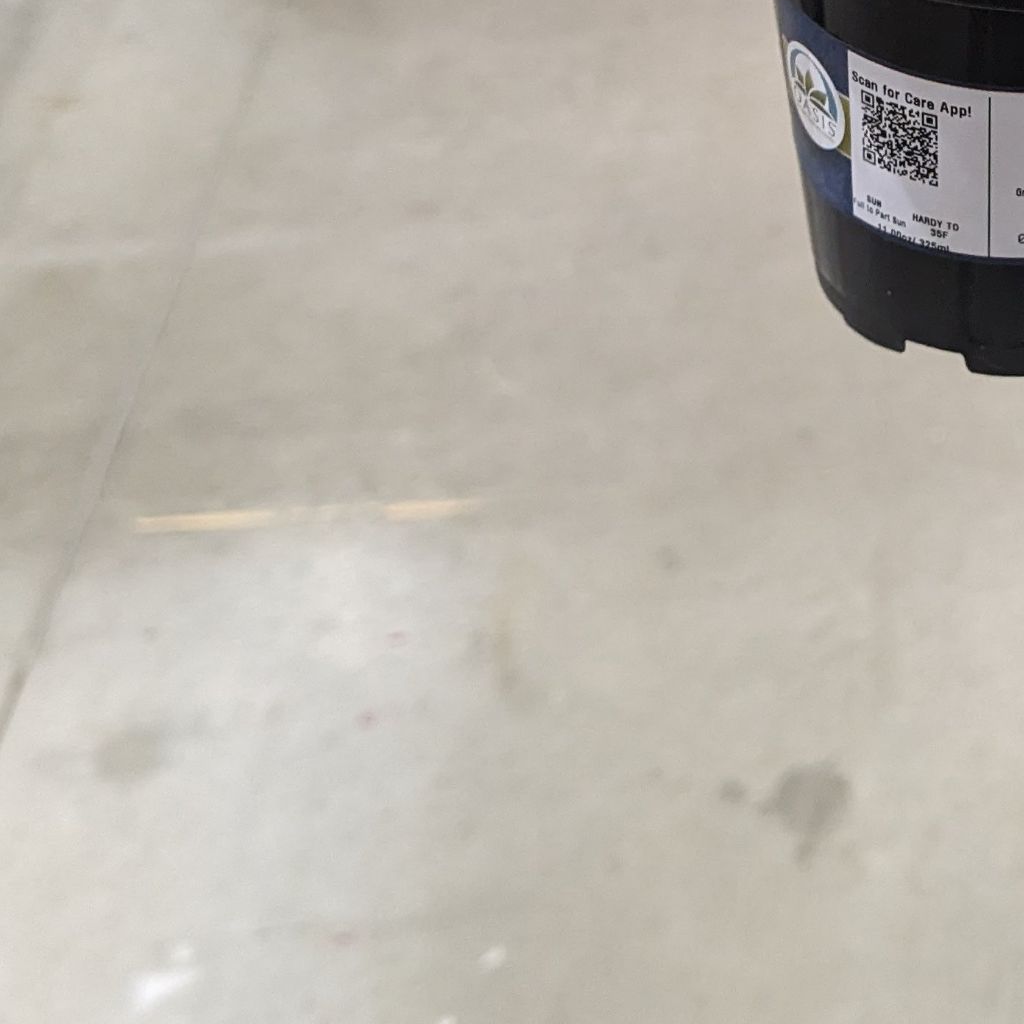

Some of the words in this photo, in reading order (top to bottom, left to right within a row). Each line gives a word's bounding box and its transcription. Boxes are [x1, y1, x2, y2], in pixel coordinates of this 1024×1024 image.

[851, 71, 878, 90] Scan
[882, 84, 900, 101] for
[904, 92, 935, 111] Care
[939, 101, 972, 118] App!
[892, 216, 906, 228] Sun
[912, 213, 943, 230] HARDY
[947, 222, 960, 232] TO
[930, 228, 949, 239] 35F
